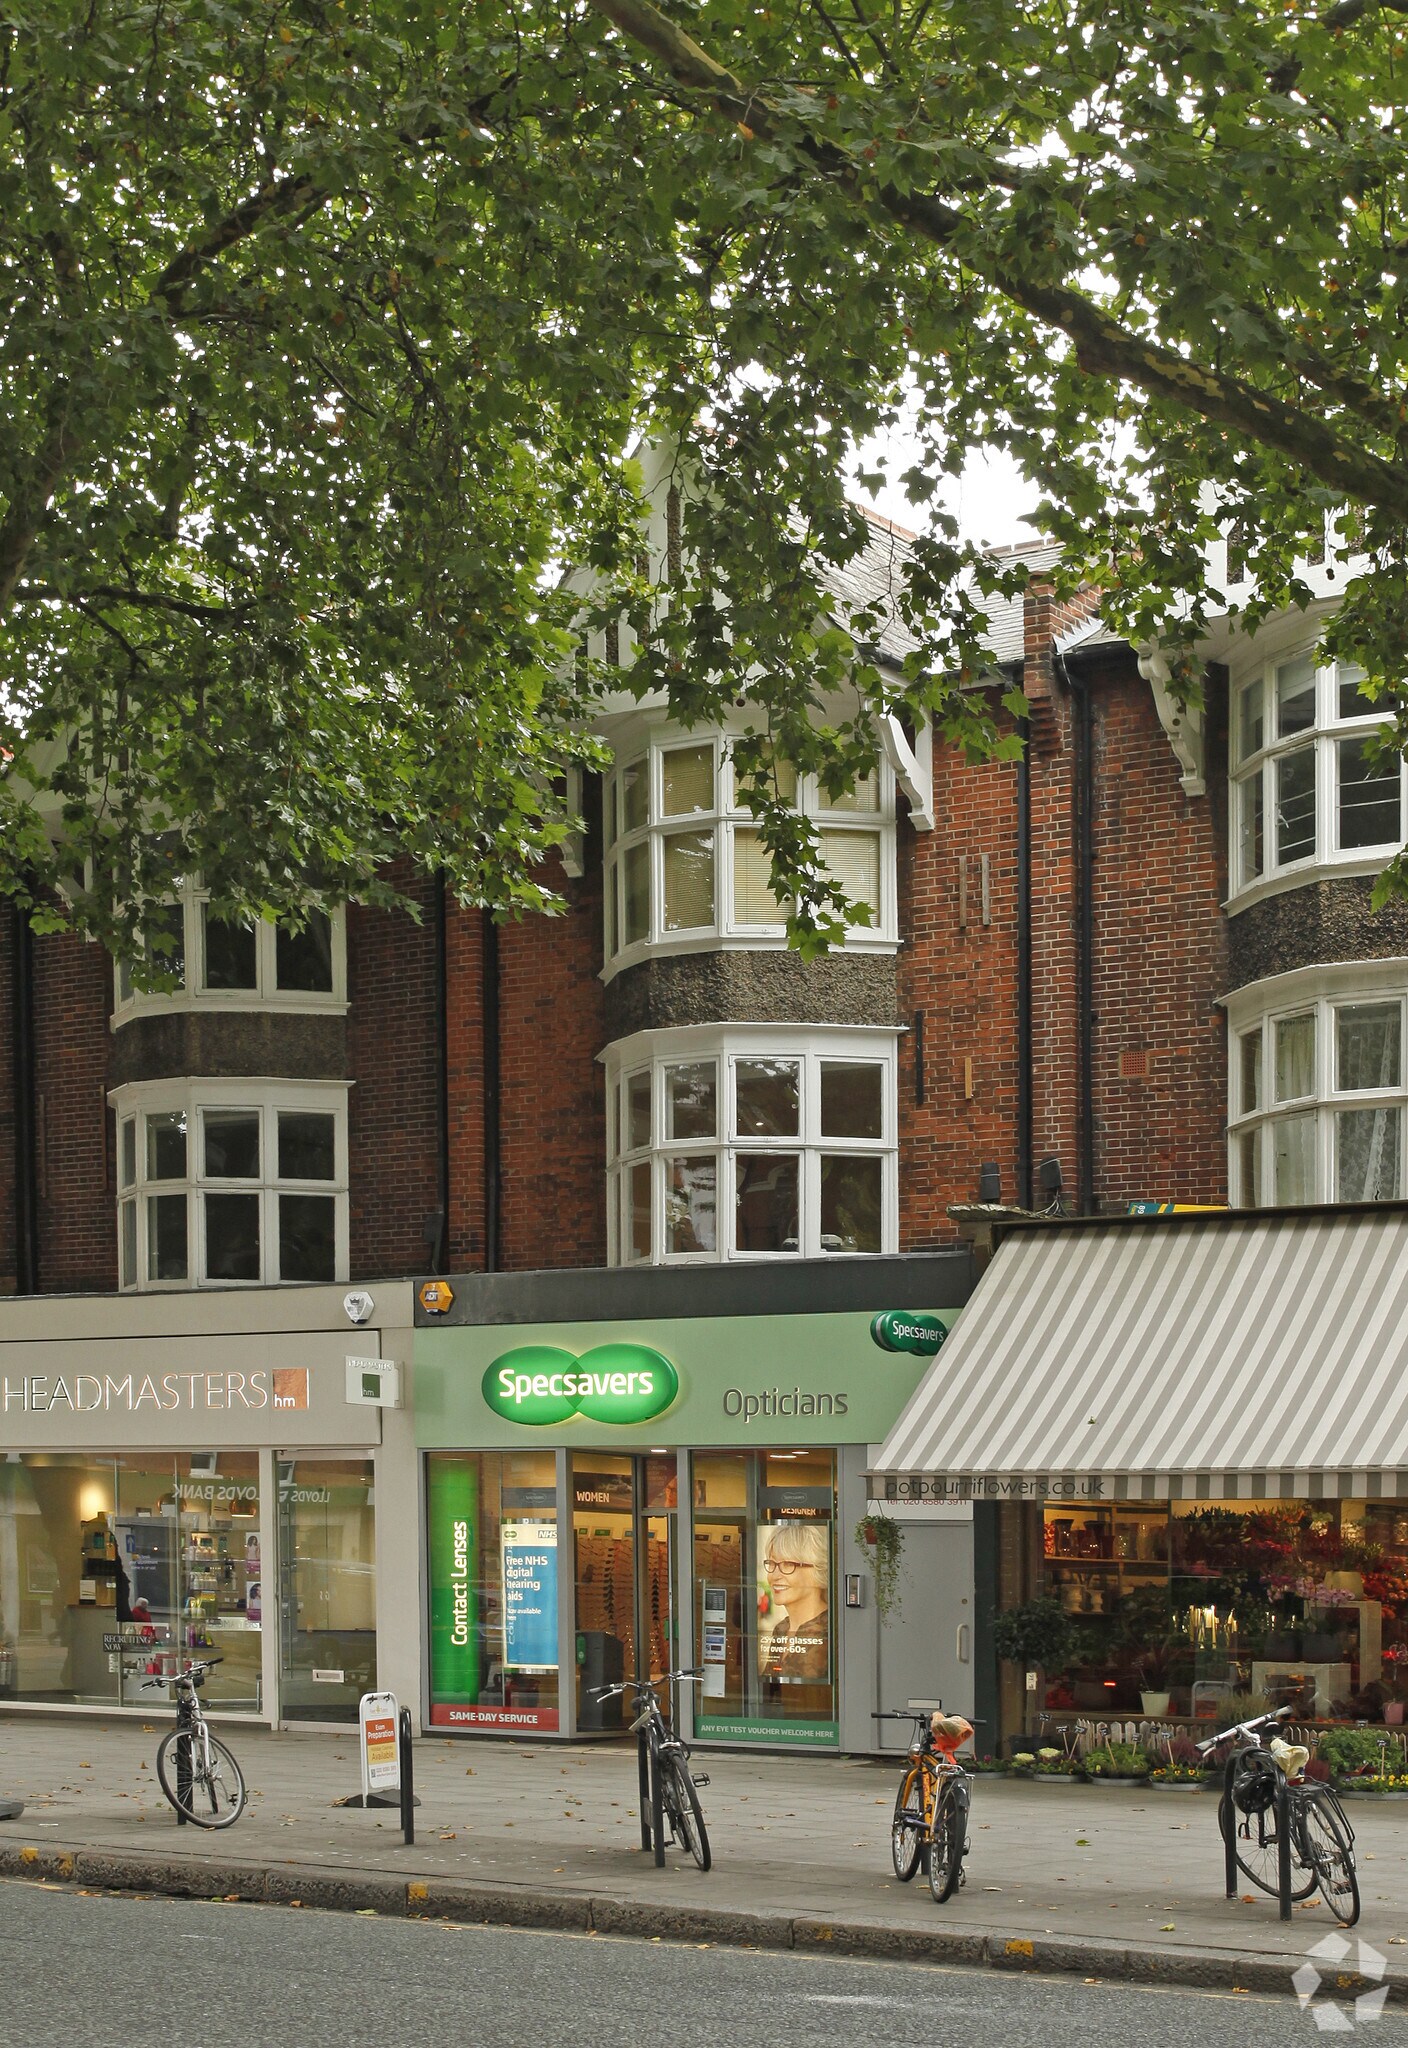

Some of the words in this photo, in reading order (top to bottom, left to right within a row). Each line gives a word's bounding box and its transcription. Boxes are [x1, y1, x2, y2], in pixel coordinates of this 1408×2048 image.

[425, 1291, 439, 1301] ADT
[892, 1320, 944, 1342] Specsavers
[3, 1371, 268, 1412] HEADMASTERS
[498, 1368, 654, 1404] Specsavers
[274, 1393, 296, 1408] hm
[722, 1387, 849, 1424] Opticians
[885, 1476, 1105, 1500] potpourriflowers.co.uk
[576, 1490, 610, 1503] WOMEN
[781, 1508, 816, 1516] DESIGNER
[538, 1530, 557, 1539] NHS
[450, 1521, 468, 1578] Lenses
[506, 1556, 523, 1565] Free
[525, 1556, 548, 1566] NHS
[506, 1567, 533, 1579] digital
[506, 1578, 541, 1591] hearing
[507, 1591, 523, 1601] aids
[450, 1582, 468, 1646] Contact
[104, 1634, 151, 1644] RECRUITING
[776, 1635, 788, 1644] off
[789, 1636, 824, 1646] glasses
[104, 1643, 122, 1651] NOW
[760, 1644, 770, 1652] for
[770, 1645, 807, 1654] over-60s
[449, 1711, 498, 1722] SAME-DAY
[498, 1713, 538, 1724] SERVICE
[368, 1730, 395, 1740] Preparation
[701, 1724, 715, 1732] ANY
[716, 1725, 729, 1733] EYE
[730, 1726, 747, 1734] TEST
[747, 1727, 780, 1735] VOUCHER
[780, 1729, 814, 1737] WELCOME
[815, 1730, 834, 1738] HERE
